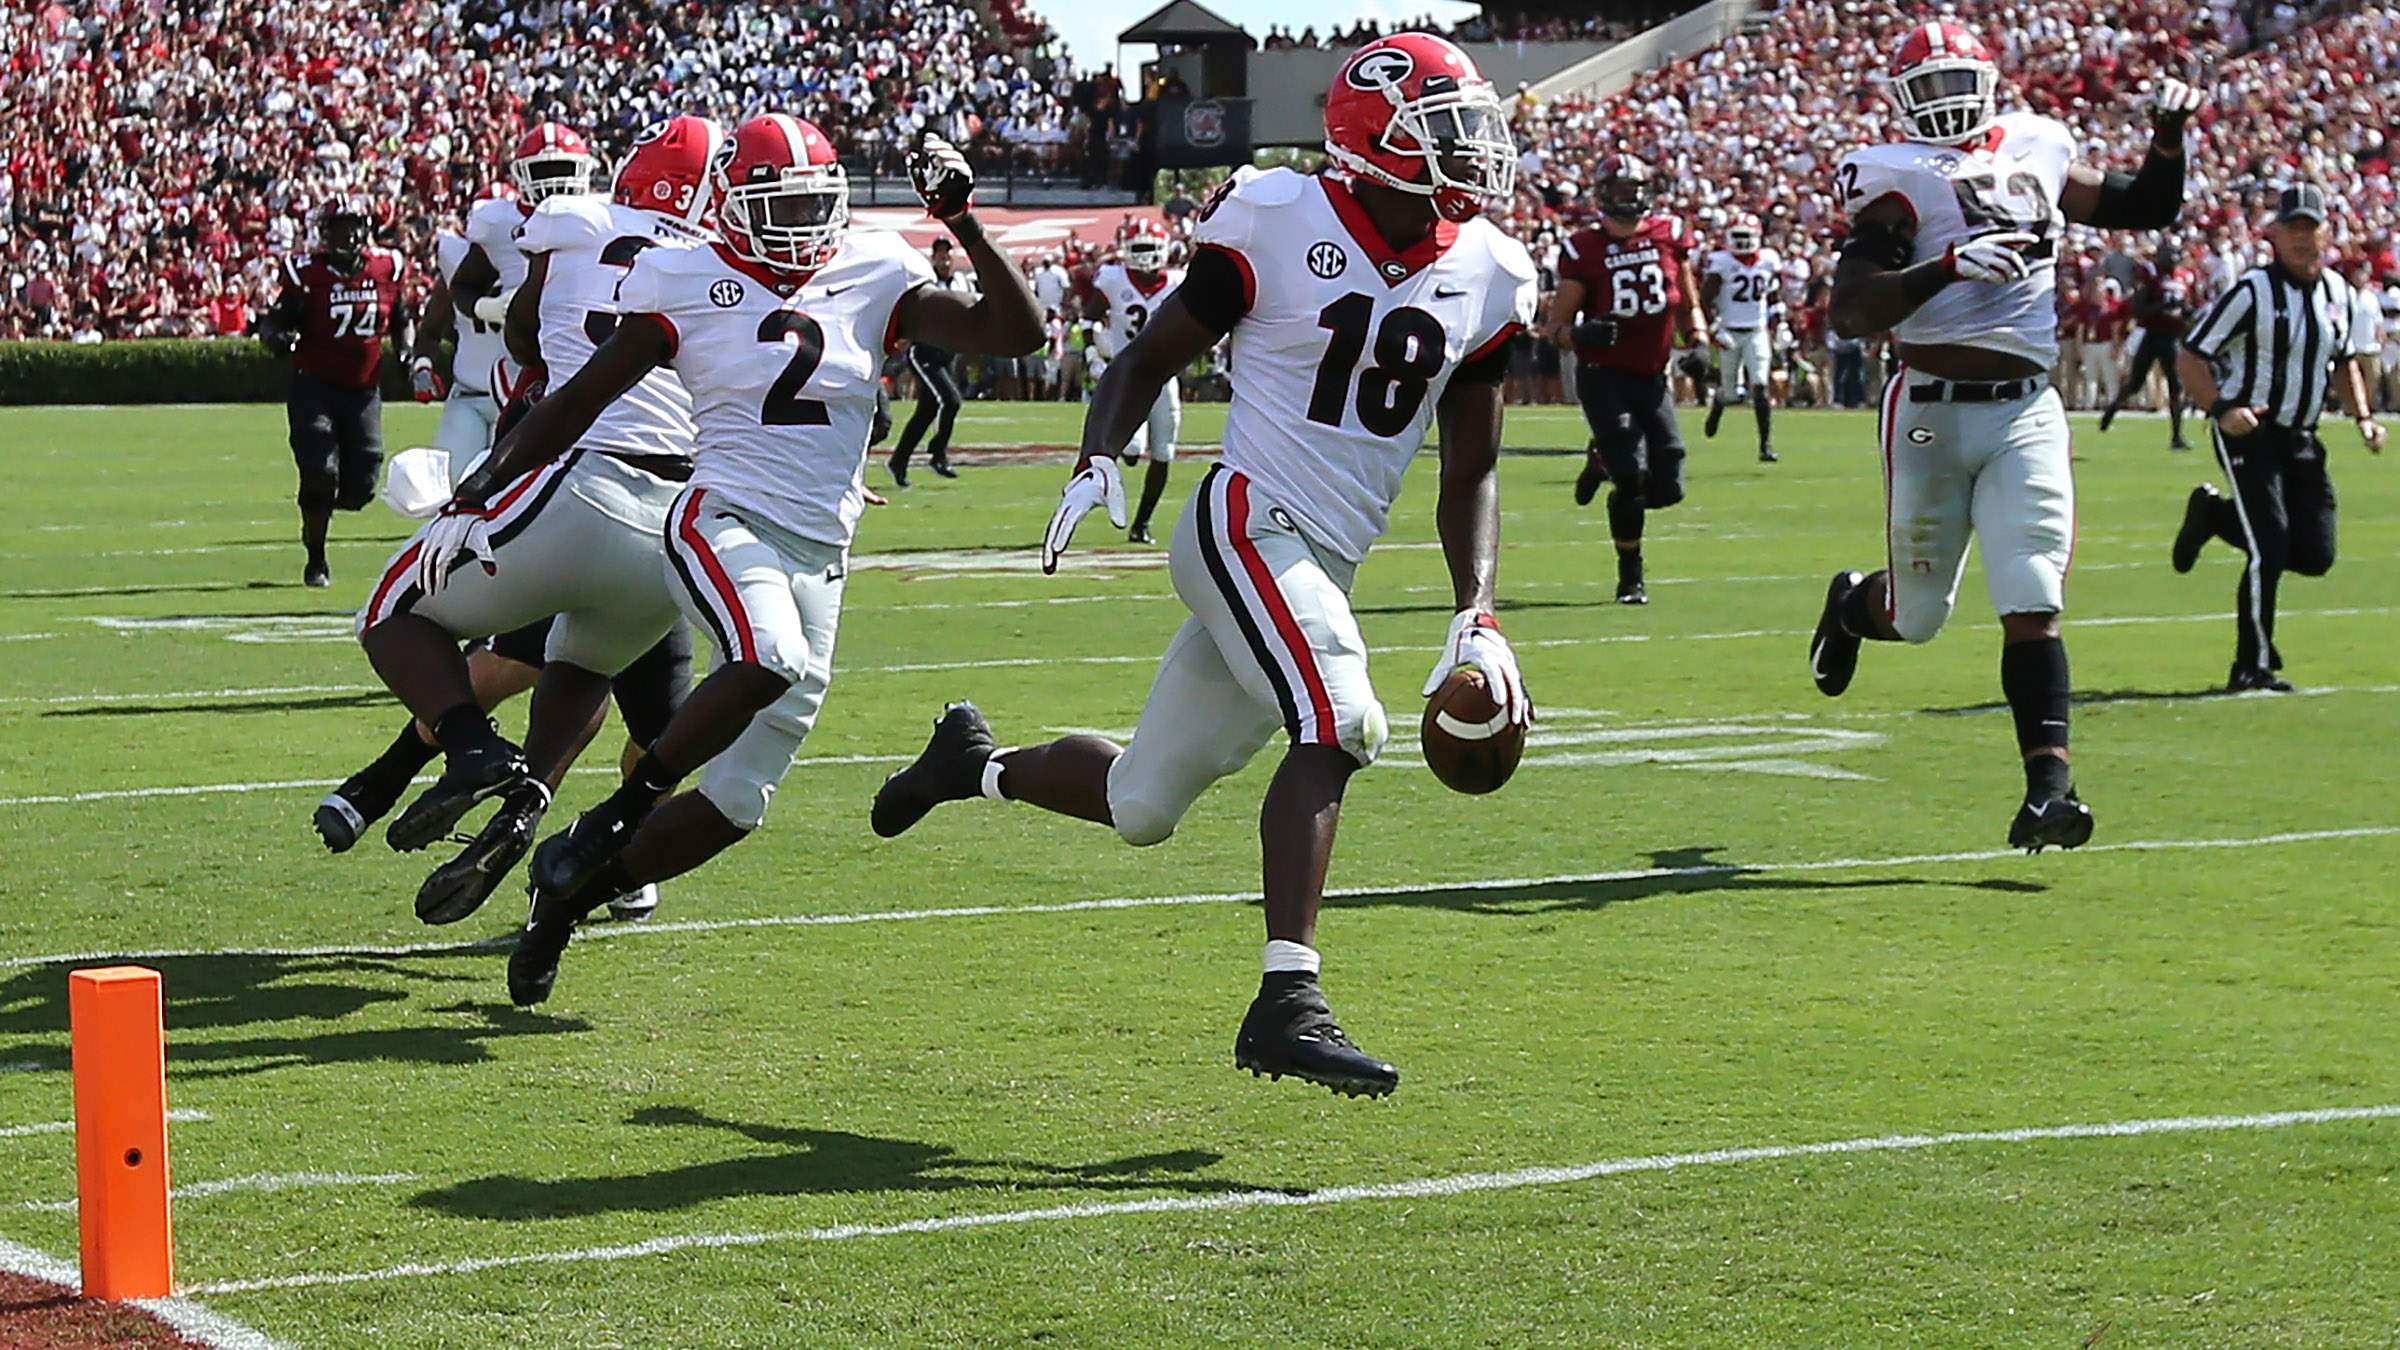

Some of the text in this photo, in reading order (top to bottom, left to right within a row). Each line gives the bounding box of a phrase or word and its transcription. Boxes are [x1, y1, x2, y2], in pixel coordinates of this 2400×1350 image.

[674, 183, 695, 211] 3
[1310, 243, 1344, 277] SEC
[712, 281, 742, 306] SEC
[1611, 263, 1668, 318] 63
[329, 301, 379, 338] 74
[757, 309, 832, 425] 2
[1306, 291, 1446, 438] 18
[1907, 426, 1934, 445] G
